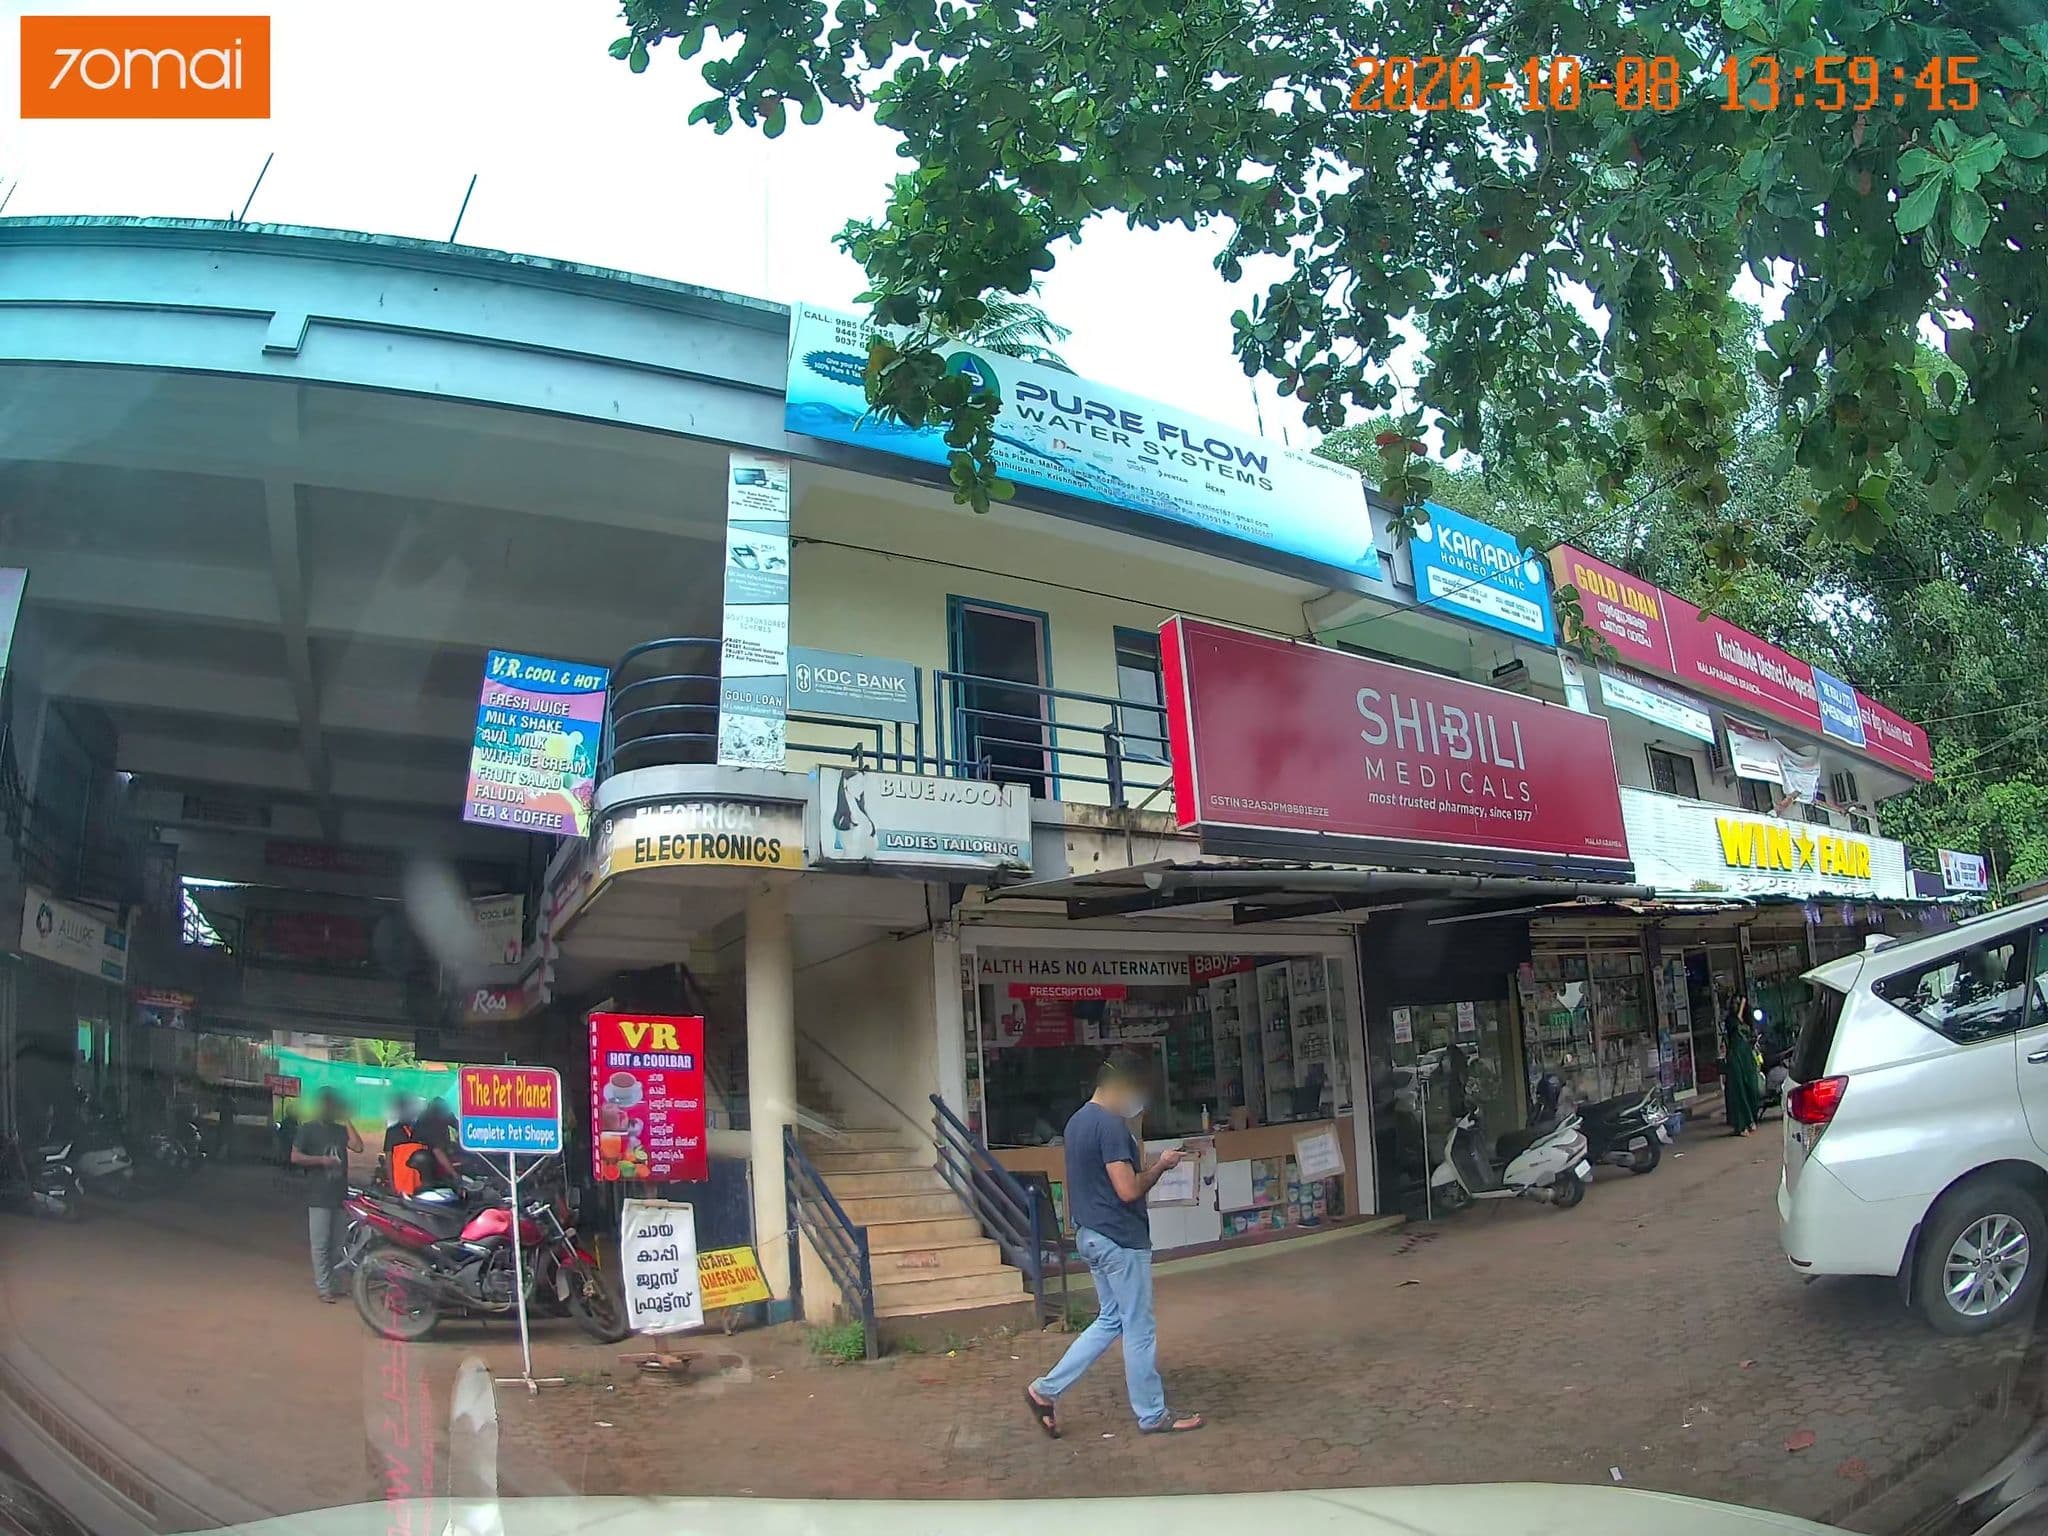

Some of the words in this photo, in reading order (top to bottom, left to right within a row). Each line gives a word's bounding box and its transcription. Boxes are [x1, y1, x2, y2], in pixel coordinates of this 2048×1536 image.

[1016, 380, 1145, 434] PURE
[1157, 421, 1268, 474] FLOW
[1016, 404, 1131, 448] WATER
[1143, 440, 1273, 491] SYSTEMS
[1574, 563, 1619, 603] GOLD
[1619, 583, 1660, 621] LOAN
[525, 667, 557, 683] COOL
[561, 672, 570, 685] &
[574, 674, 602, 690] HOT
[814, 667, 852, 685] KDC
[856, 672, 907, 691] BANK
[489, 692, 530, 711] FRESH
[532, 697, 570, 716] JUICE
[725, 690, 752, 703] GOLD
[755, 694, 782, 707] LOAN
[485, 710, 518, 727] MILK
[520, 715, 563, 734] SHAKE
[1356, 687, 1526, 771] SHIBILI
[482, 728, 510, 746] AVIL
[513, 733, 548, 752] MILK
[480, 747, 518, 766] WITH
[518, 752, 539, 769] ICE
[540, 756, 588, 776] CREAM
[477, 766, 518, 785] FRUIT
[519, 771, 563, 790] SALAD
[1365, 756, 1531, 802] MEDICALS
[474, 784, 525, 805] FALUDA
[881, 780, 936, 801] BLUE
[1210, 795, 1240, 808] GSTIN
[472, 803, 496, 819] TEA
[499, 807, 511, 823] &
[513, 808, 563, 829] COFFEE
[1368, 792, 1397, 806] most
[1399, 794, 1436, 811] trusted
[1438, 799, 1489, 818] pharmacy,
[1489, 806, 1513, 820] since
[1513, 808, 1533, 823] 1977
[634, 832, 781, 864] ELECTRONICS
[886, 834, 938, 850] LADIES
[941, 838, 1019, 857] TAILORING
[1715, 816, 1793, 872] WIN
[1818, 834, 1873, 880] FAIR
[1028, 960, 1060, 975] HAS
[1065, 960, 1088, 975] NO
[1091, 960, 1189, 976] ALTERNATIVE
[1029, 985, 1102, 997] PRESCRIPTION
[618, 1021, 681, 1051] VR
[610, 1053, 631, 1067] HOT
[633, 1054, 642, 1067] &
[643, 1054, 693, 1069] COOLBAR
[466, 1073, 491, 1107] The
[492, 1074, 512, 1108] Pet
[516, 1075, 552, 1109] Planet
[467, 1123, 505, 1144] Complete
[508, 1123, 522, 1141] Pet
[524, 1124, 555, 1147] Shoppe
[637, 1223, 674, 1239] ചായ
[637, 1244, 679, 1263] കാപ്പി
